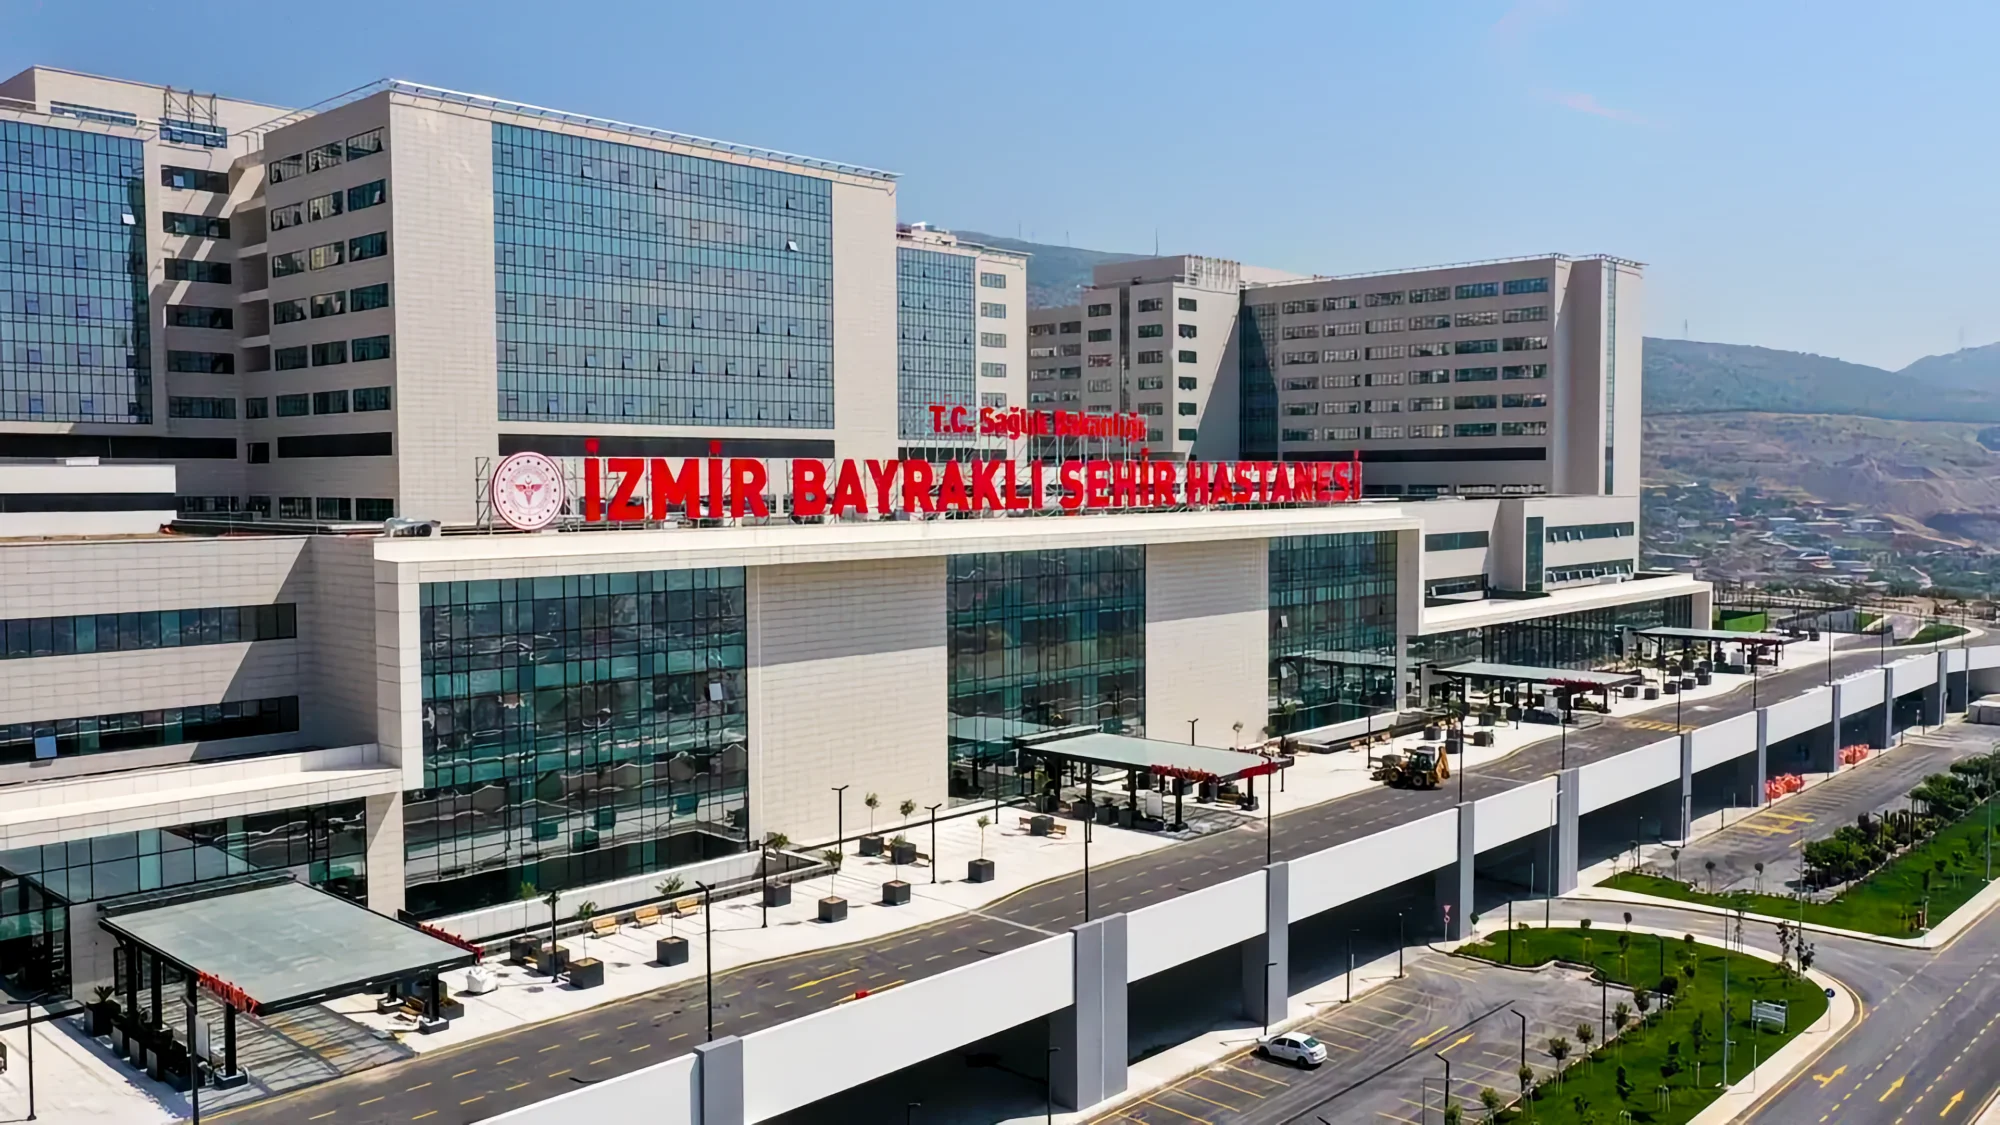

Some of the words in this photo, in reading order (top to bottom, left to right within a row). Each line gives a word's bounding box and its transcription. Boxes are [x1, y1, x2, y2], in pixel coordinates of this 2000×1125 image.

[929, 405, 974, 433] T.C.
[585, 438, 770, 522] İZMİR
[792, 458, 1042, 515] BAYRAKLI
[1186, 449, 1361, 504] HASTANESİ
